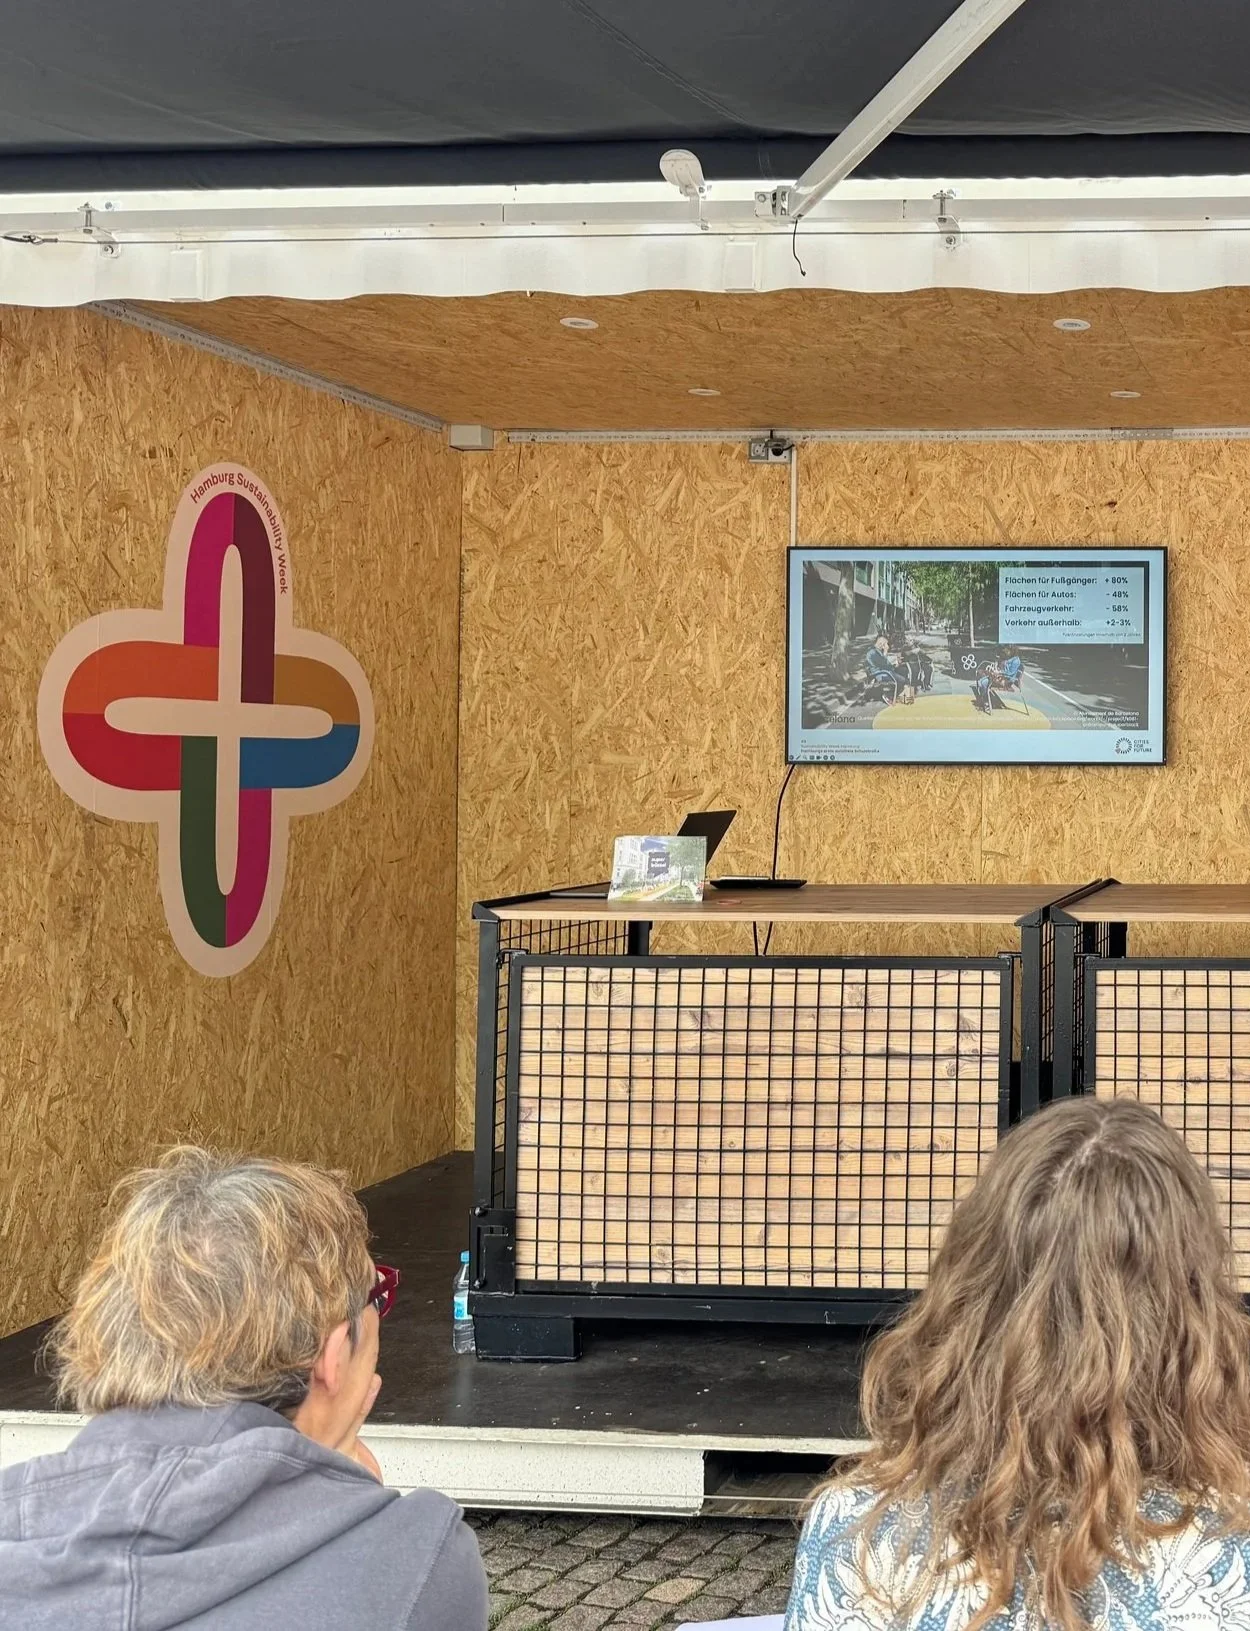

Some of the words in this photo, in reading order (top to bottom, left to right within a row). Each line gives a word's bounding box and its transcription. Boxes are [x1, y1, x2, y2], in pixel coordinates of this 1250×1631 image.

[190, 472, 235, 504] Hamburg
[236, 472, 283, 551] Sustainability
[277, 553, 289, 595] Week
[1005, 576, 1037, 584] Flächen
[1038, 576, 1050, 584] für
[1051, 576, 1098, 586] Fußgänger:
[1111, 576, 1129, 584] 80%
[1005, 590, 1037, 598] Flächen
[1038, 590, 1050, 598] für
[1051, 590, 1077, 598] Autos:
[1112, 590, 1129, 598] 48%
[1005, 604, 1075, 614] Fahrzeugverkehr:
[1112, 604, 1129, 612] 58%
[1005, 618, 1036, 626] Verkehr
[1037, 618, 1082, 626] außerhalb:
